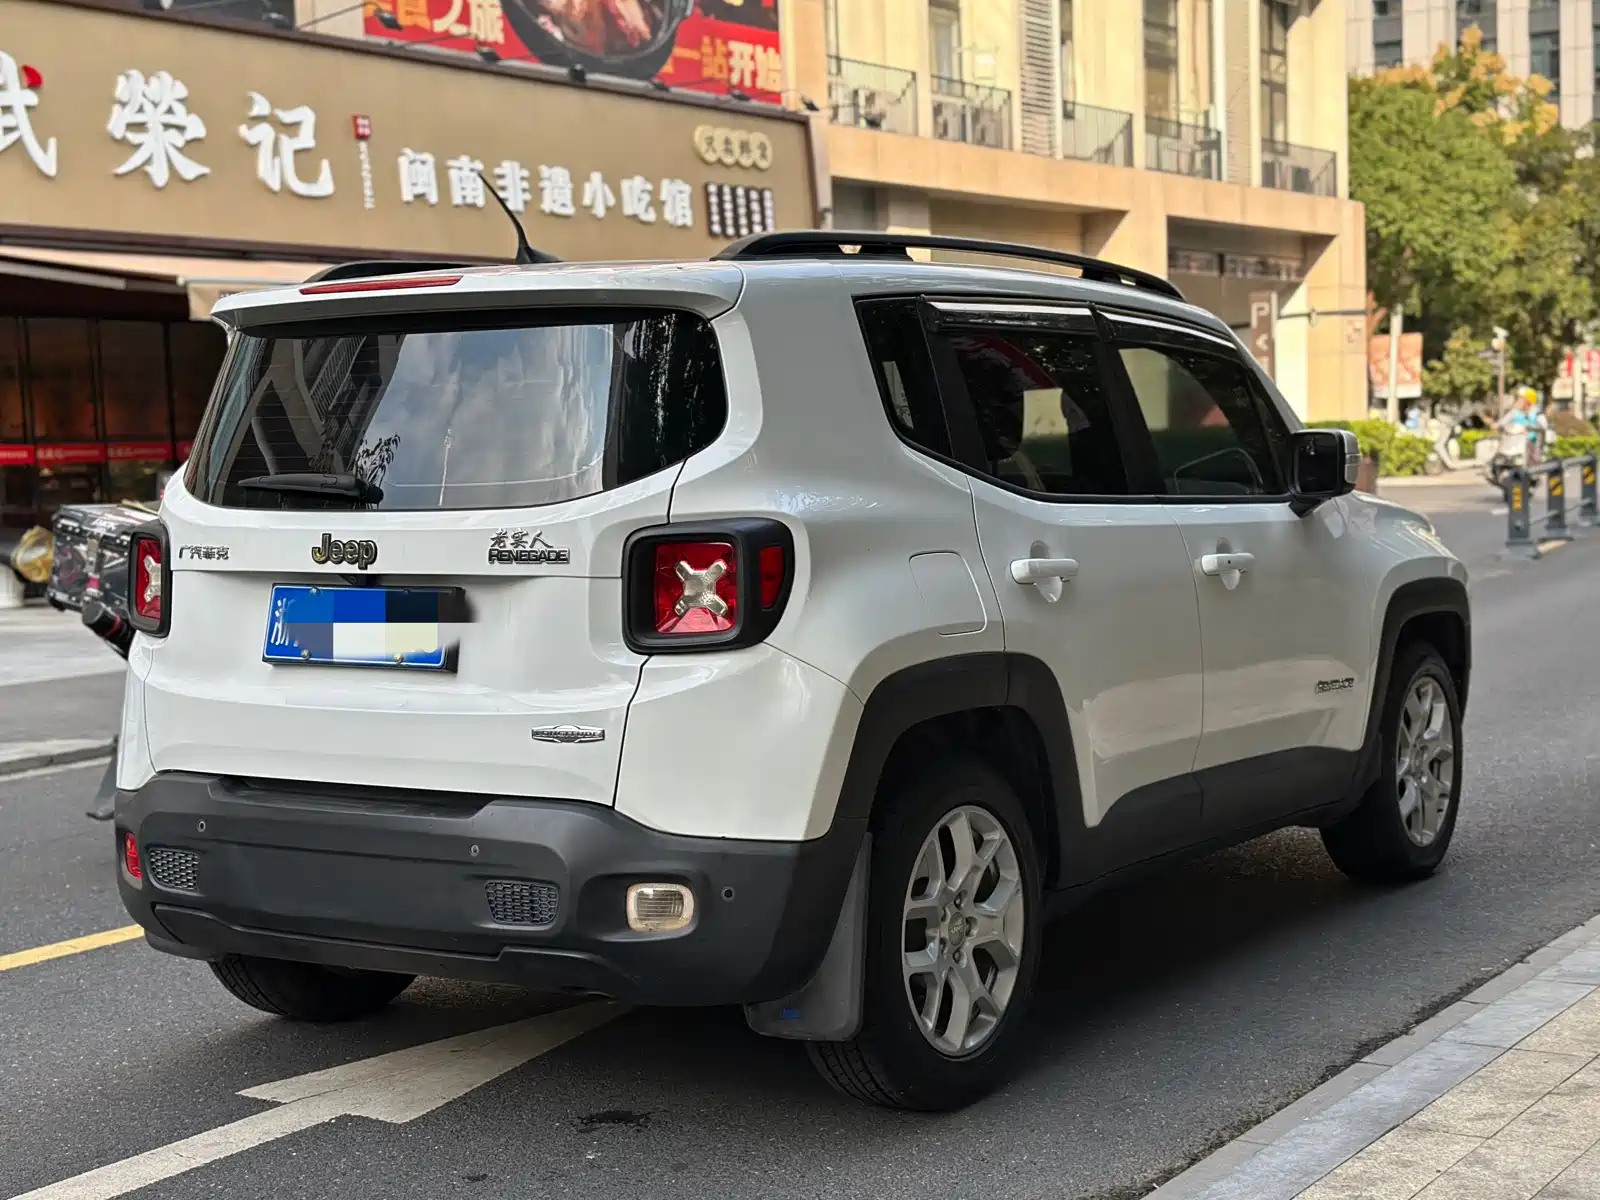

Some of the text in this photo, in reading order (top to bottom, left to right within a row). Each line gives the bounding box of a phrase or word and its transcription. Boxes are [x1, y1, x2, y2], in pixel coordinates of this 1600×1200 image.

[398, 148, 693, 227] 闽南非遗小吃馆
[179, 545, 230, 560] 广汽菲克
[311, 533, 378, 570] Jeep
[488, 548, 570, 564] RENEGADE
